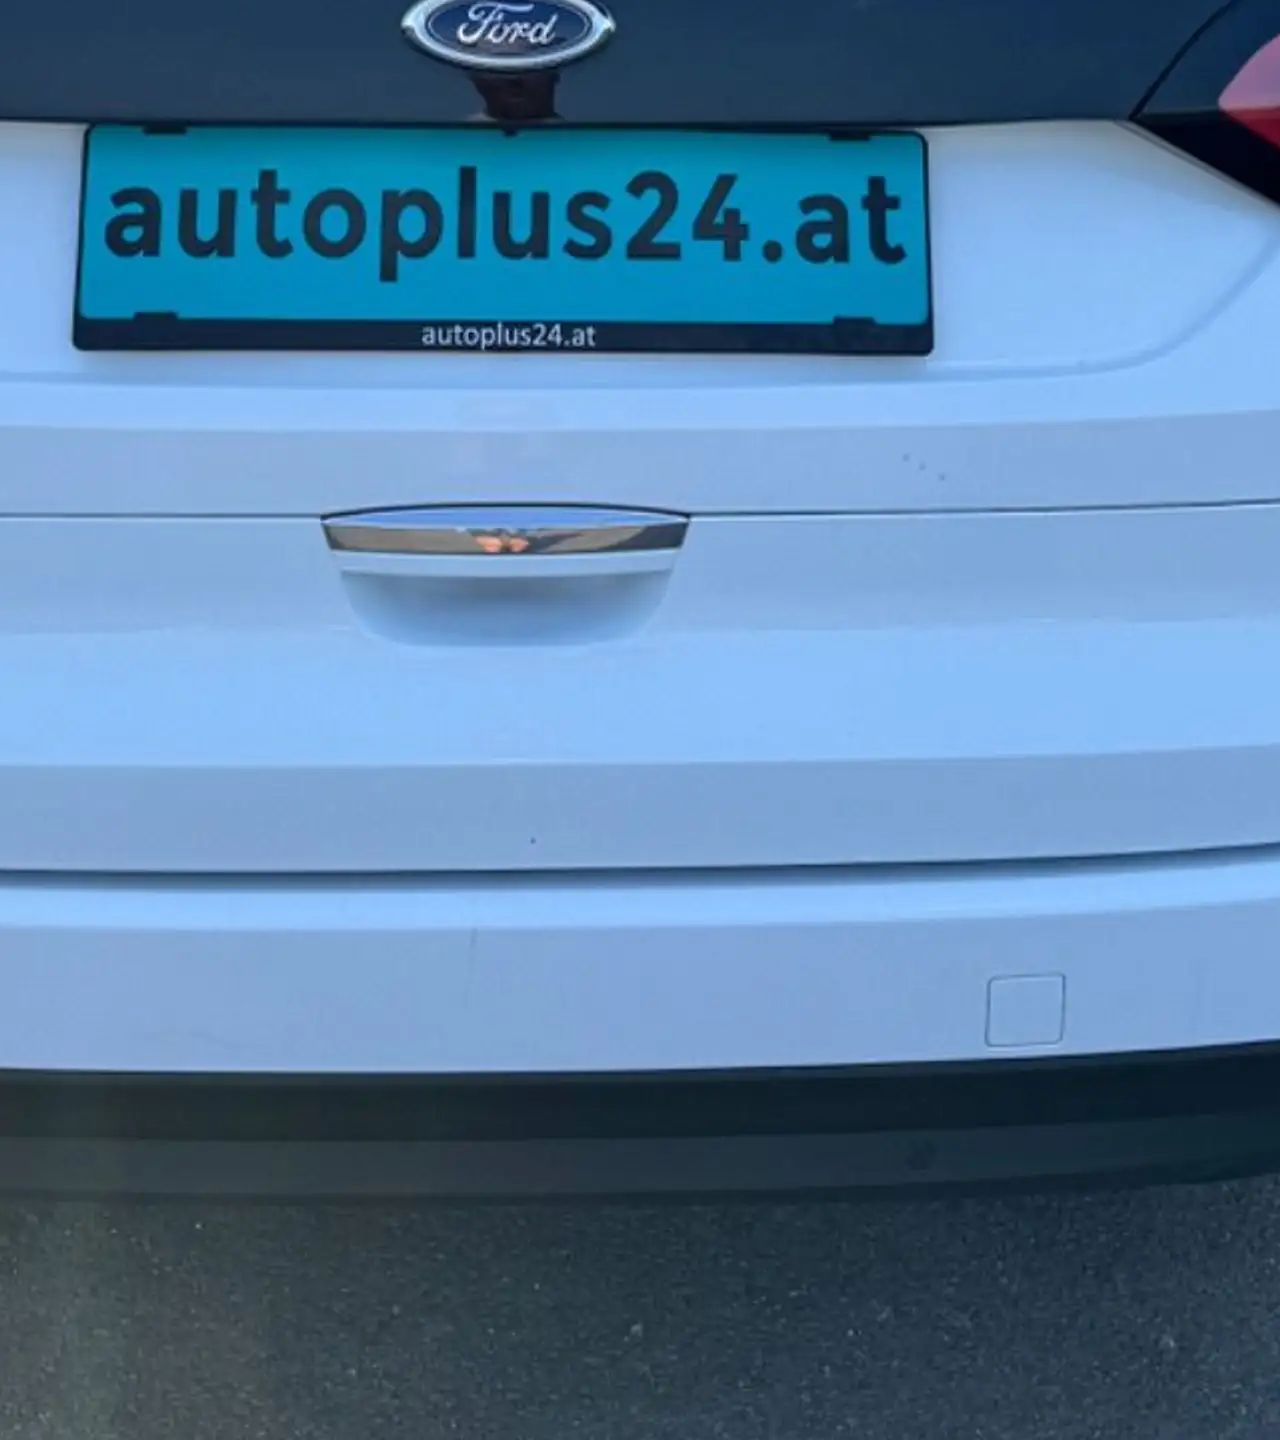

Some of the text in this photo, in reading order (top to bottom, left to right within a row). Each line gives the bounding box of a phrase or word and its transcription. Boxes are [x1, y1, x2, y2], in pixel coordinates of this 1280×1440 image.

[457, 1, 558, 44] Ford
[104, 166, 907, 282] autoplus24.at
[421, 321, 597, 350] autoplus24.at
